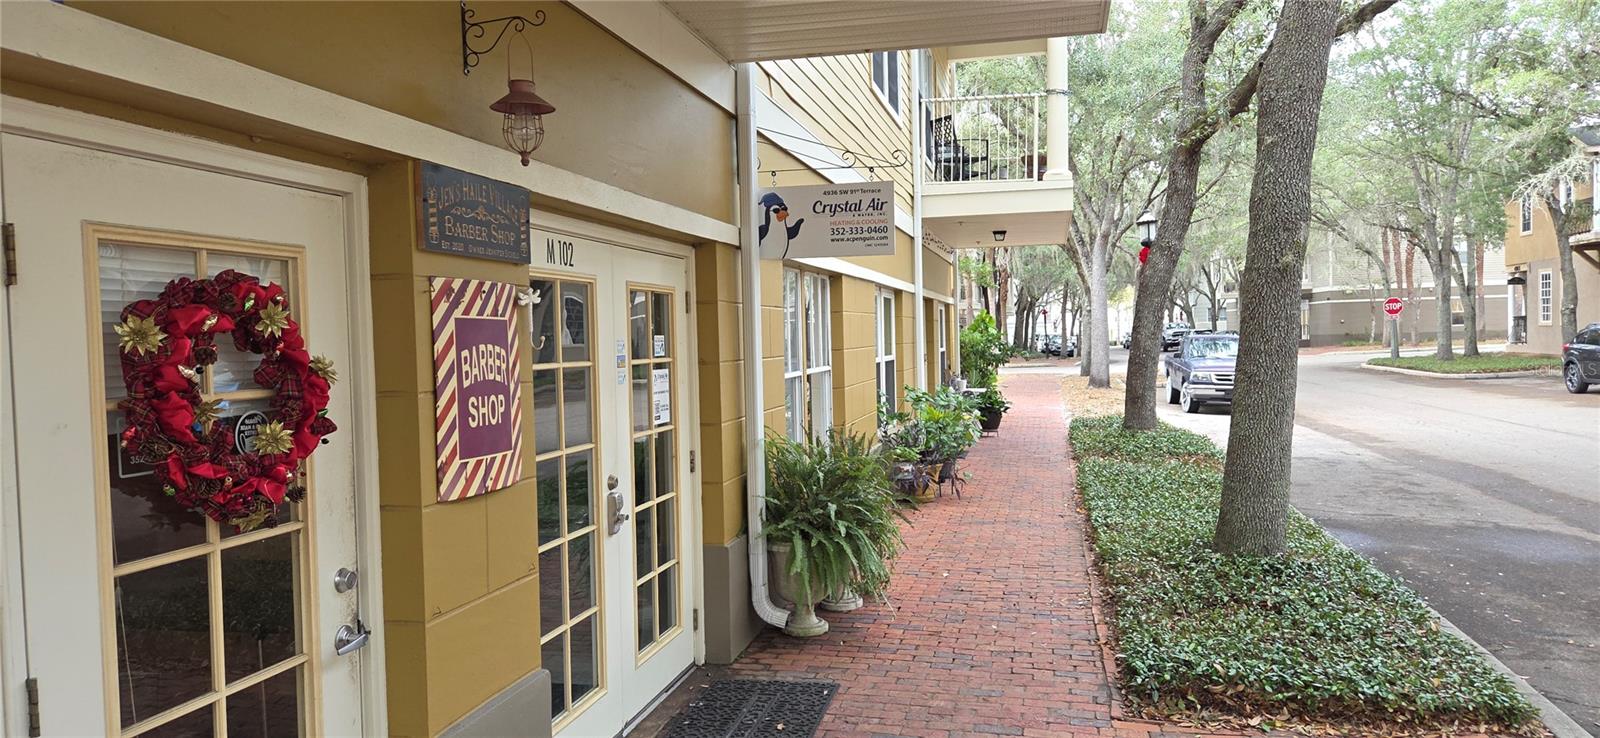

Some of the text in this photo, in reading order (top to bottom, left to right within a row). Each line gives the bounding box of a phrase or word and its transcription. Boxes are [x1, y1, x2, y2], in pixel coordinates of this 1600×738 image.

[462, 179, 487, 203] HAILE
[812, 197, 888, 217] Crystal Air
[444, 215, 516, 246] BARBER SHOP
[830, 225, 888, 236] 352-333-0460
[830, 235, 888, 243] www.acpenguin.com
[547, 238, 574, 267] M 102
[461, 343, 508, 388] BARBER
[468, 394, 506, 428] SHOP
